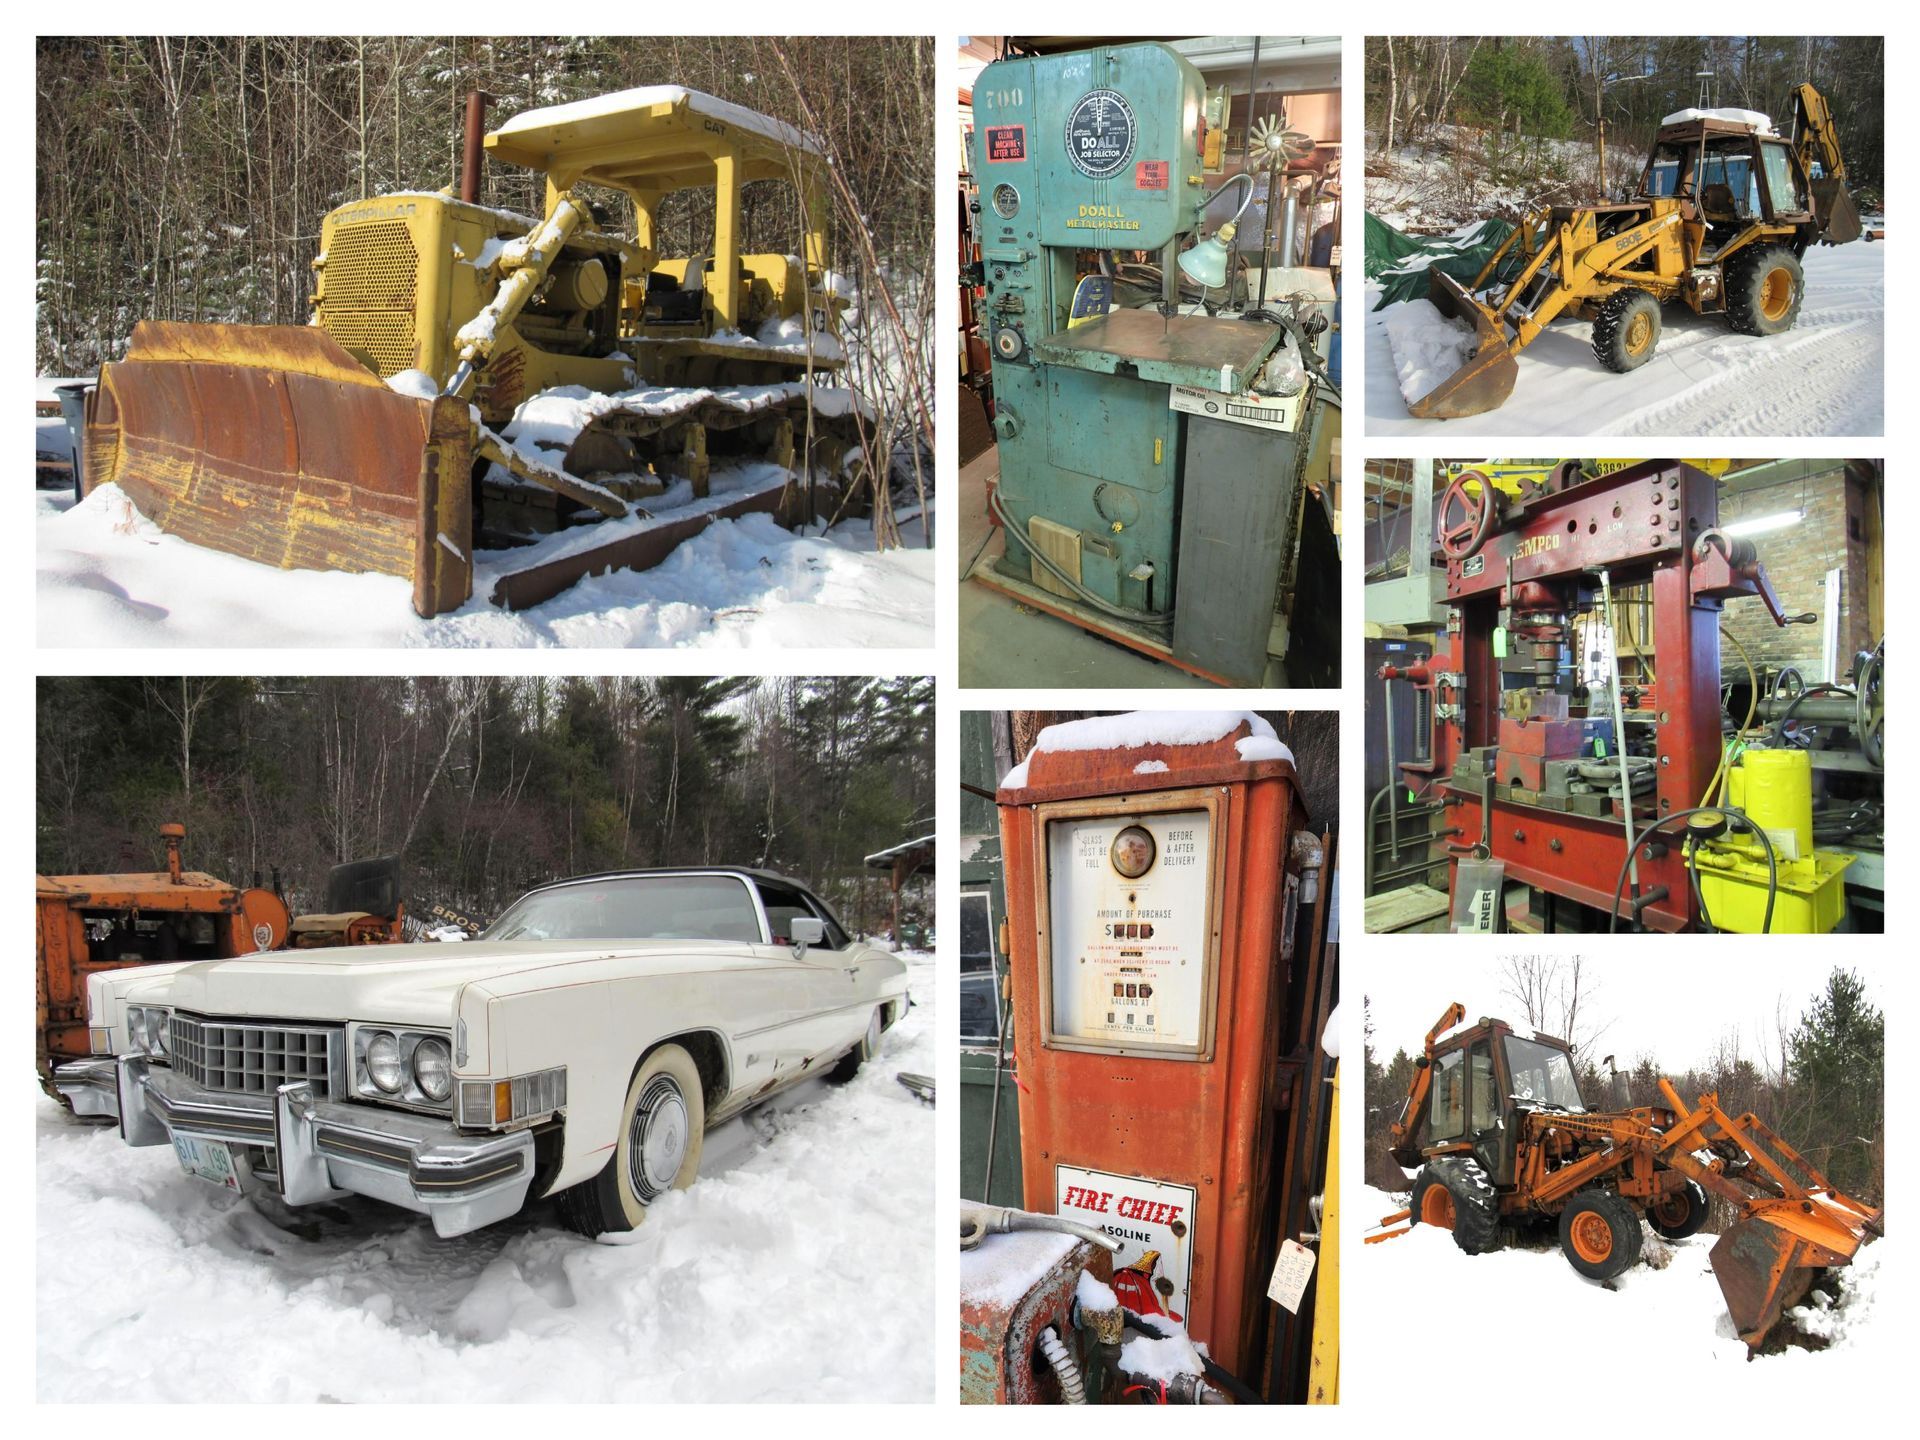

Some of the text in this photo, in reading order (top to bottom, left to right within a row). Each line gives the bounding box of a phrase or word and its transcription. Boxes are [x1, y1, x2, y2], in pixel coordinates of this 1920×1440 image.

[986, 88, 1023, 109] 700
[704, 119, 726, 136] CAT
[998, 131, 1013, 140] CLEAN
[993, 148, 1020, 157] AFTER USE
[1092, 150, 1120, 158] SELECTOR
[1144, 163, 1158, 171] WEAR
[332, 203, 416, 224] CATERPILLAR
[1079, 205, 1125, 218] DOALL
[1066, 218, 1140, 231] METALMASTER
[1615, 230, 1643, 251] 580E
[1175, 387, 1197, 398] MOTOR
[1197, 392, 1206, 400] OIL
[1512, 534, 1560, 560] EMPCO
[1168, 830, 1193, 841] BEFORE
[1099, 847, 1108, 856] BE
[1173, 843, 1195, 853] AFTER
[1085, 859, 1100, 868] FULL
[1164, 856, 1196, 866] DELIVERY
[1096, 909, 1172, 919] AMOUNT OF PURCHASE
[1111, 998, 1149, 1007] GALLONS AT
[206, 1144, 230, 1174] 199
[1063, 1186, 1184, 1227] FIRE CHIEF
[1101, 1223, 1152, 1243] ASOLINE
